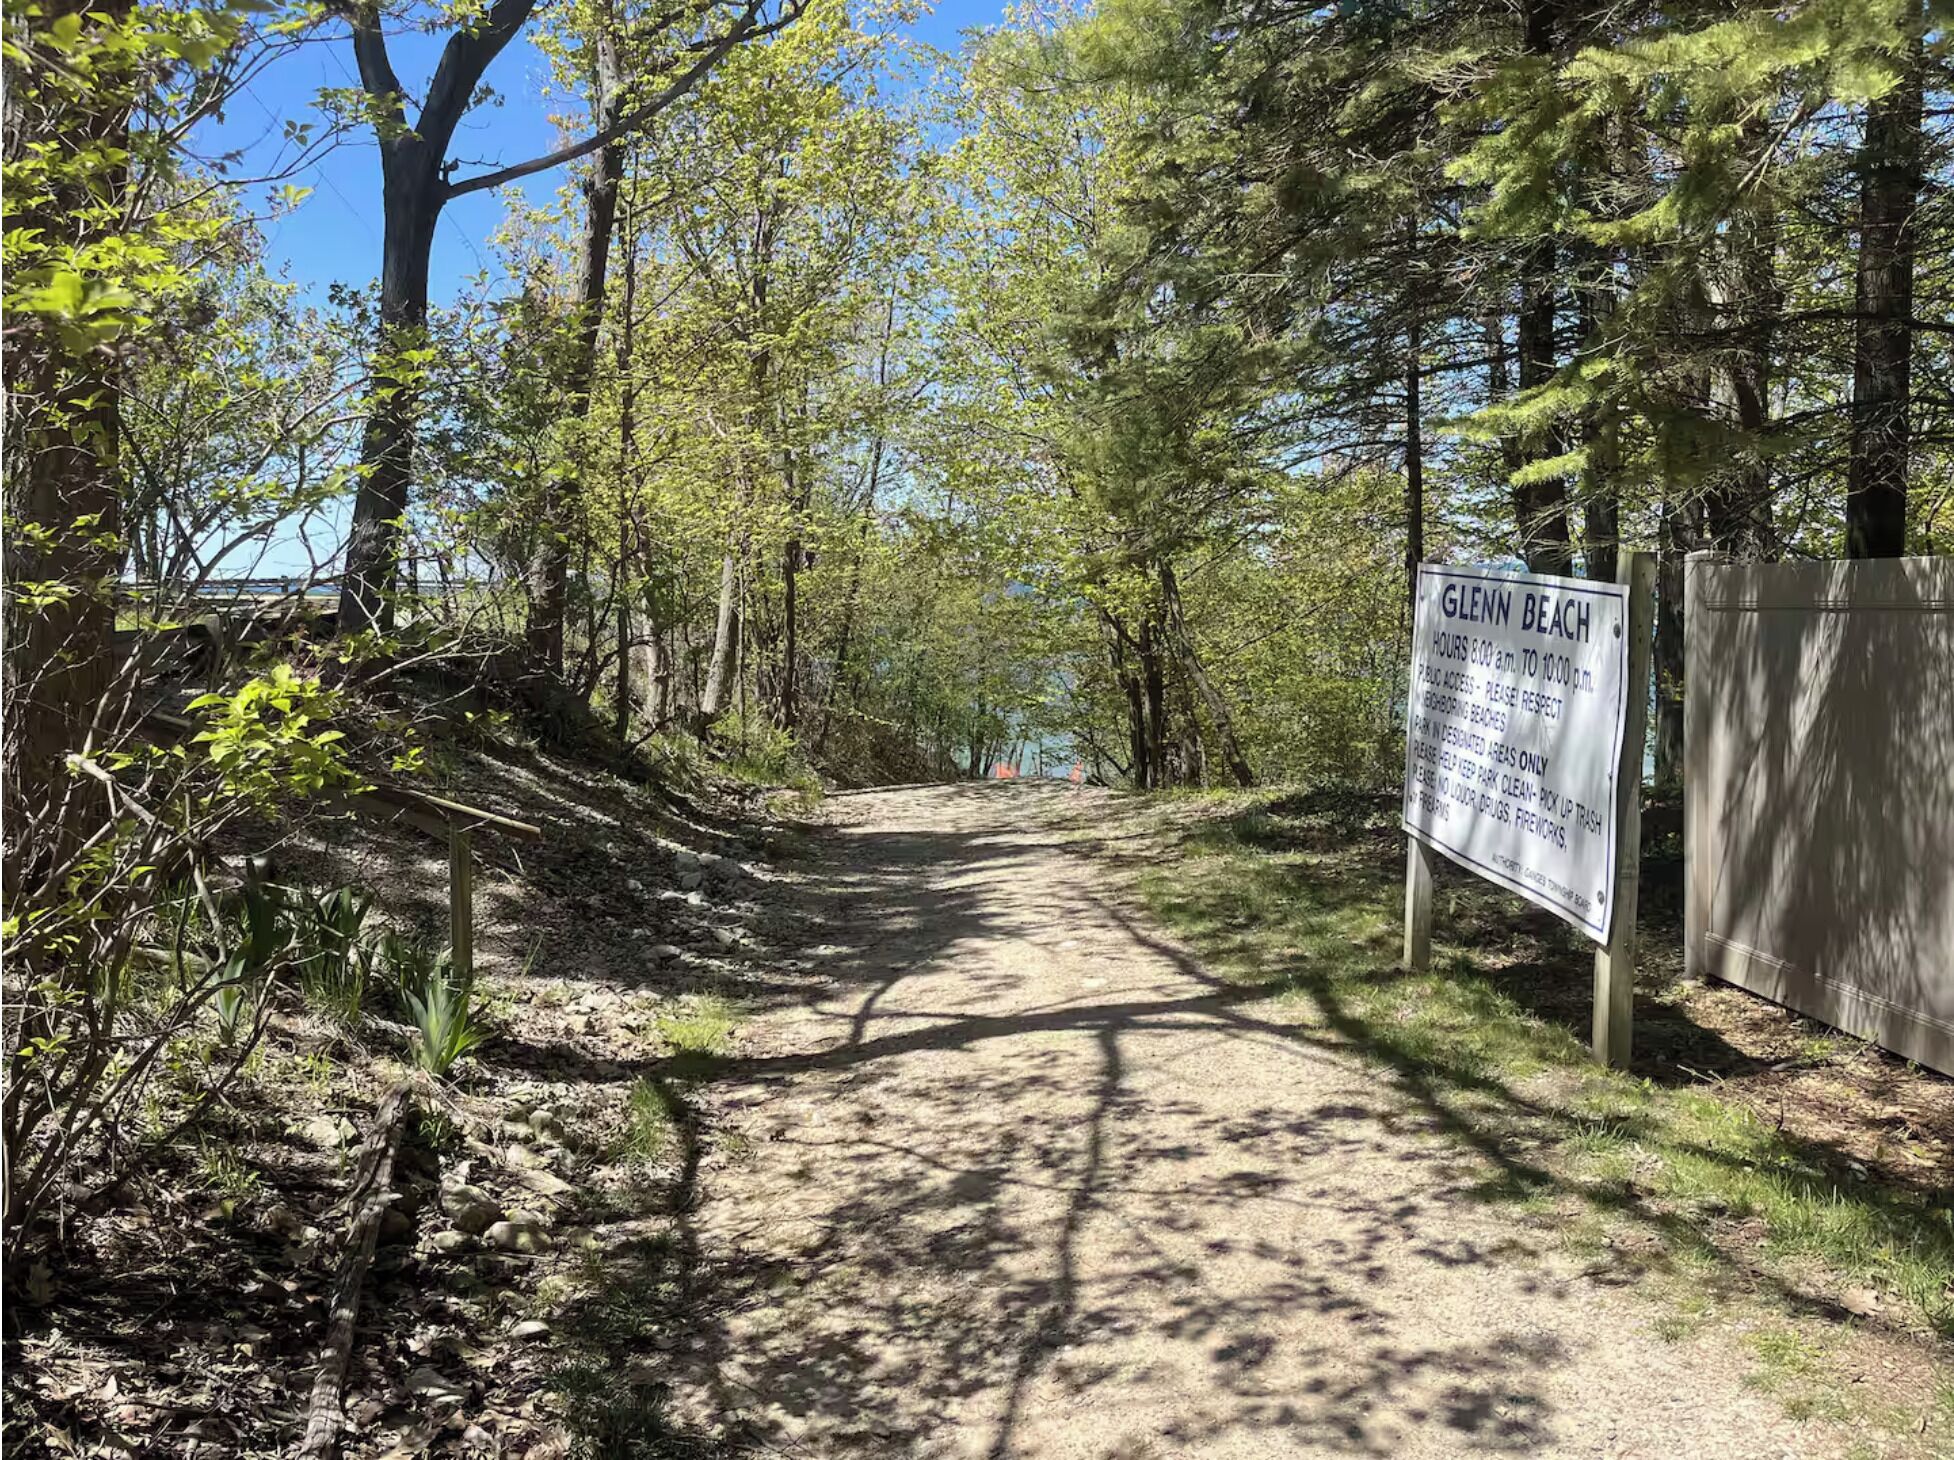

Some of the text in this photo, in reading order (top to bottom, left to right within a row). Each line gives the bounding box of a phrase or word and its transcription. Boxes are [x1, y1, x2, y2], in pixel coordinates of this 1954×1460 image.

[1442, 583, 1590, 643] GLENN BEACH
[1418, 663, 1441, 686] PUBLIC
[1443, 670, 1474, 695] ACCESS
[1522, 690, 1562, 720] RESPECT
[1433, 630, 1468, 662] HOURS
[1495, 650, 1515, 673] a.m.
[1522, 648, 1538, 677] TO
[1542, 652, 1570, 686] 10:00
[1572, 667, 1594, 696] p.m.
[1415, 714, 1549, 777] PARK IN DESIGNATED AREAS ONLY
[1470, 703, 1506, 733] BEACHES
[1413, 739, 1437, 765] PLEASE
[1439, 747, 1457, 772] HELP
[1459, 755, 1477, 780] KEEP
[1477, 765, 1499, 792] PARK
[1539, 787, 1559, 815] PICK
[1561, 797, 1573, 820] UP
[1576, 802, 1602, 836] TRASH
[1419, 790, 1449, 822] FIREARMS
[1438, 774, 1448, 796] NO
[1479, 793, 1512, 828] DRUGS,
[1515, 807, 1567, 852] FIREWORKS,
